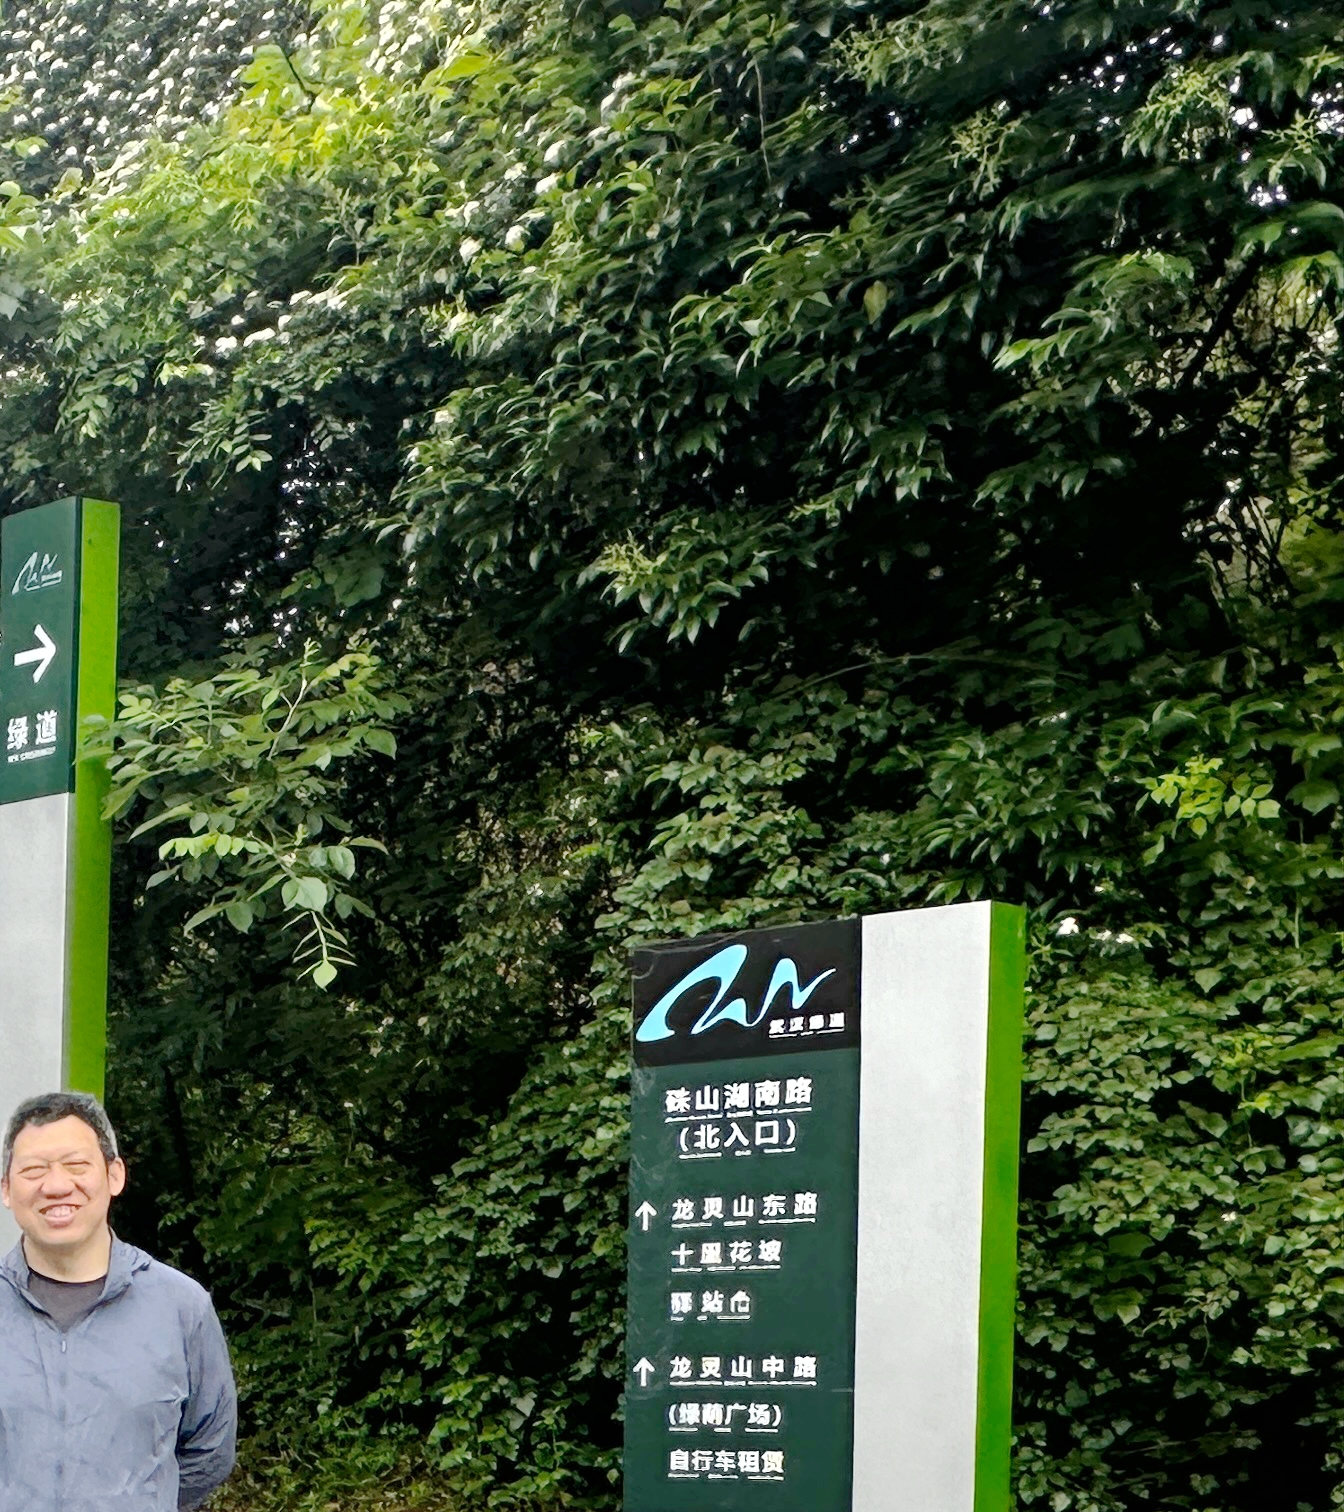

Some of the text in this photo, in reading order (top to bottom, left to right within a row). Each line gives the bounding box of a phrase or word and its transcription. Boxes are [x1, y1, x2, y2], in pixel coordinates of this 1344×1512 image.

[7, 710, 57, 750] 绿道
[679, 1118, 797, 1151] (北入口)
[669, 1355, 817, 1379] 龙灵山中路
[669, 1449, 785, 1473] 自行车租赁
